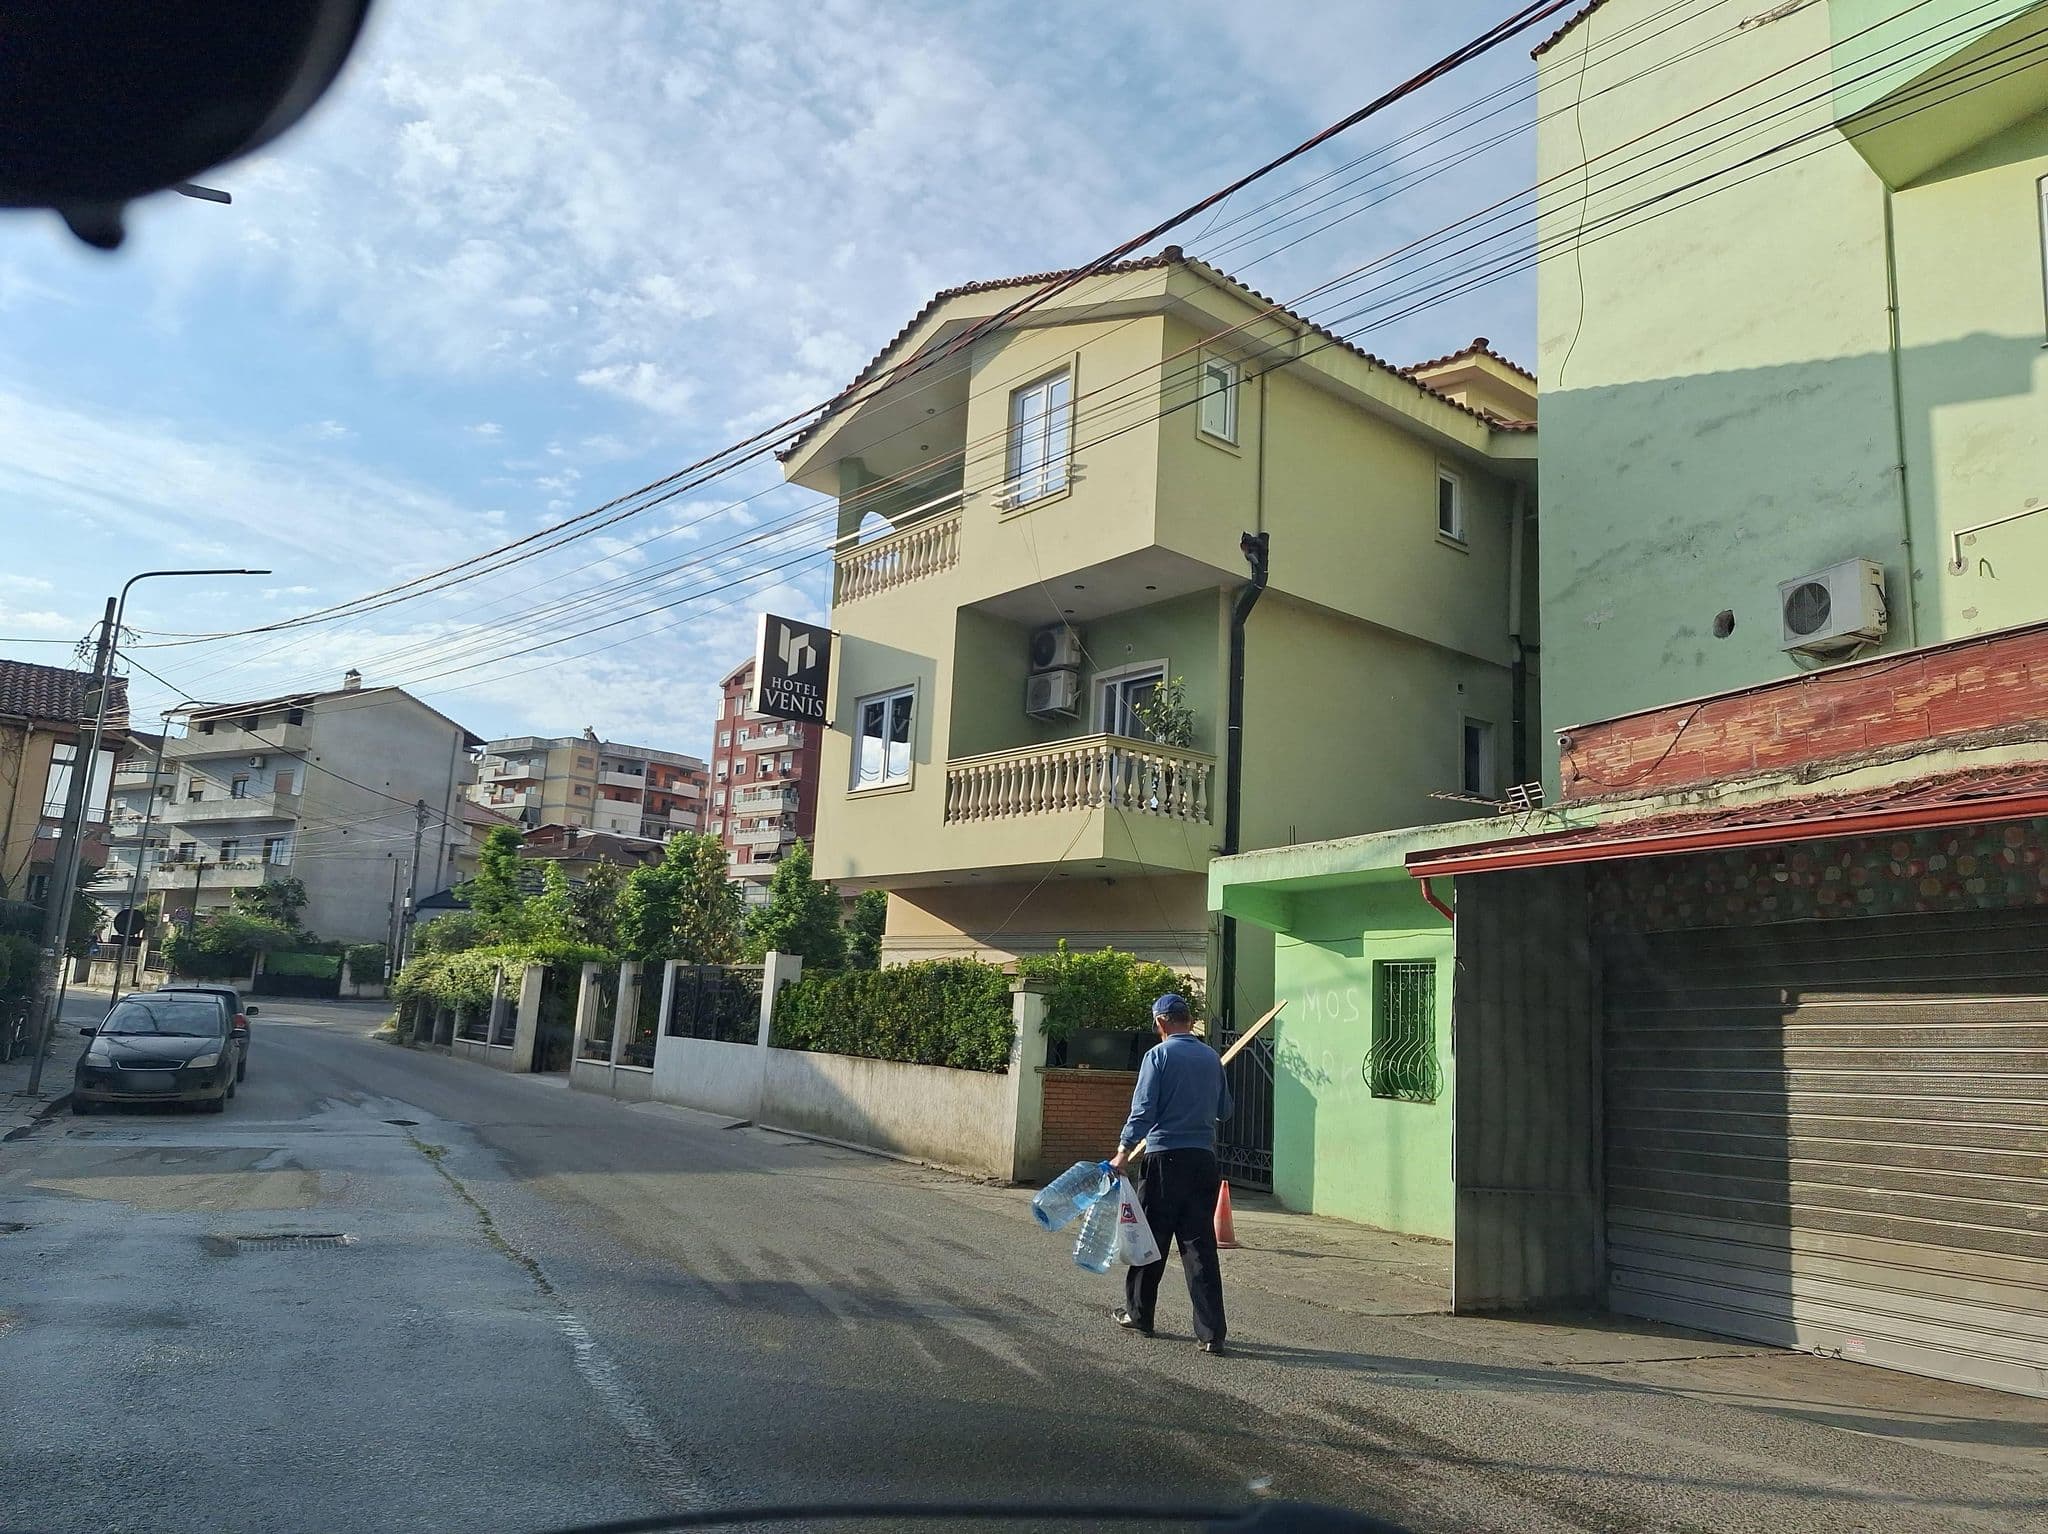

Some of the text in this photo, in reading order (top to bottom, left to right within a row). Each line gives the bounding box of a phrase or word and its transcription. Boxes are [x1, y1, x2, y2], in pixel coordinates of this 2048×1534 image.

[771, 676, 818, 697] HOTEL
[765, 688, 824, 717] VENIS
[1302, 987, 1359, 1023] MOS
